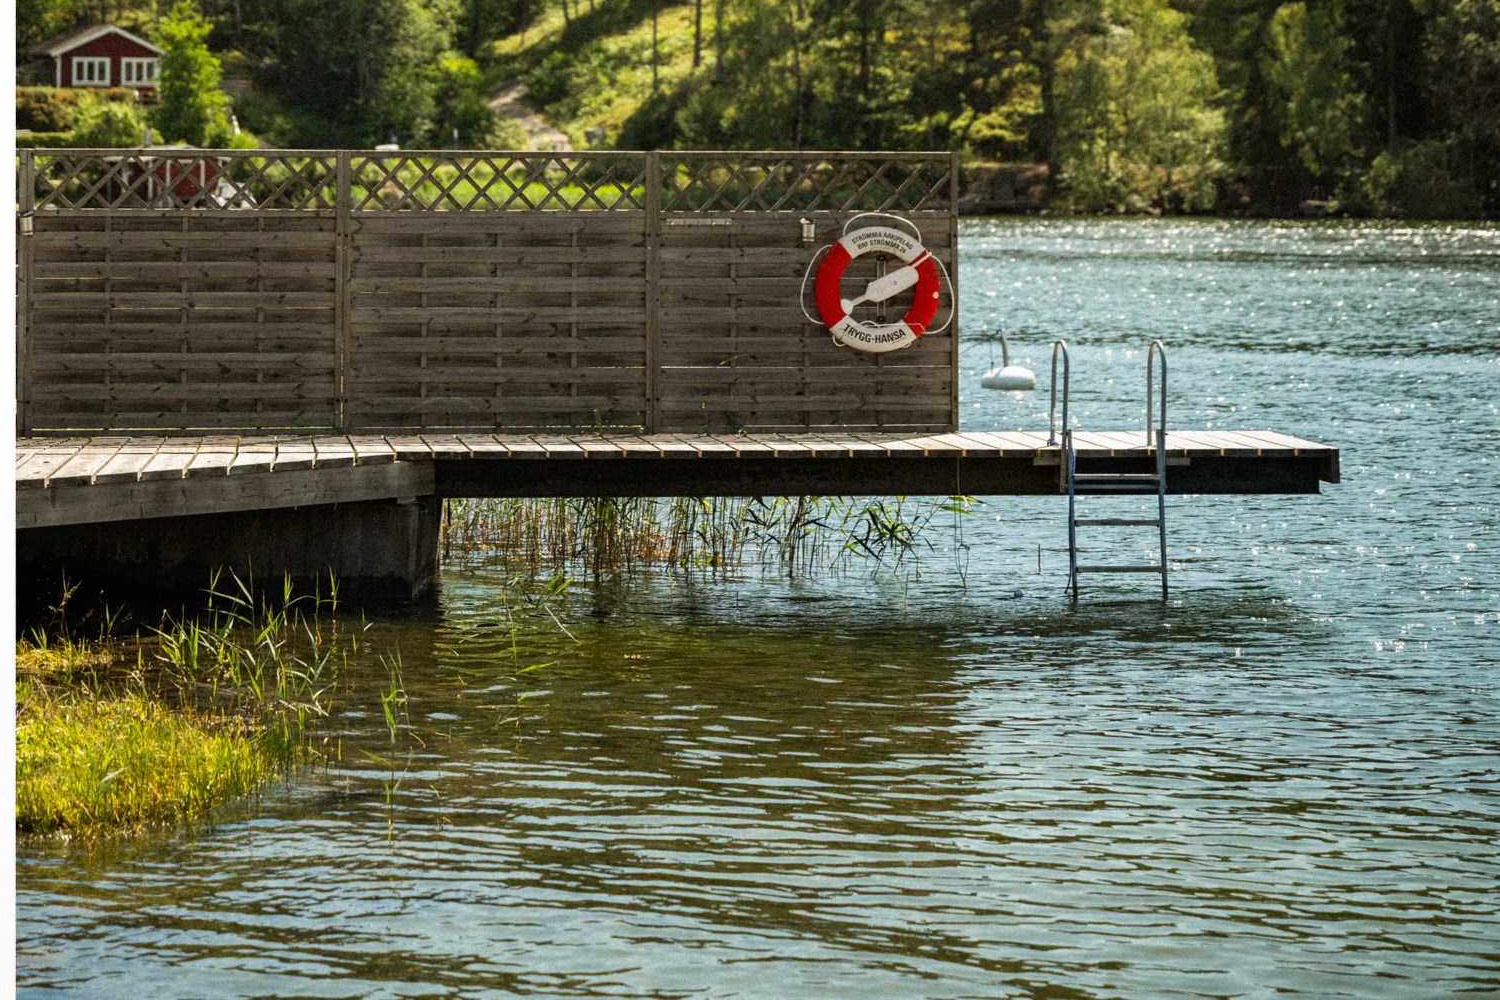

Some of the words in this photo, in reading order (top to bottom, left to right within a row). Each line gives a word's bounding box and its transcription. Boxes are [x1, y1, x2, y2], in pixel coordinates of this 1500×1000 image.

[851, 232, 883, 244] STRÖMMA
[883, 232, 914, 250] ARKIPELAG
[857, 240, 869, 250] BRF
[869, 239, 900, 250] STRÖMMA
[899, 246, 907, 254] 24
[843, 323, 907, 344] TRYGG-HANSA
